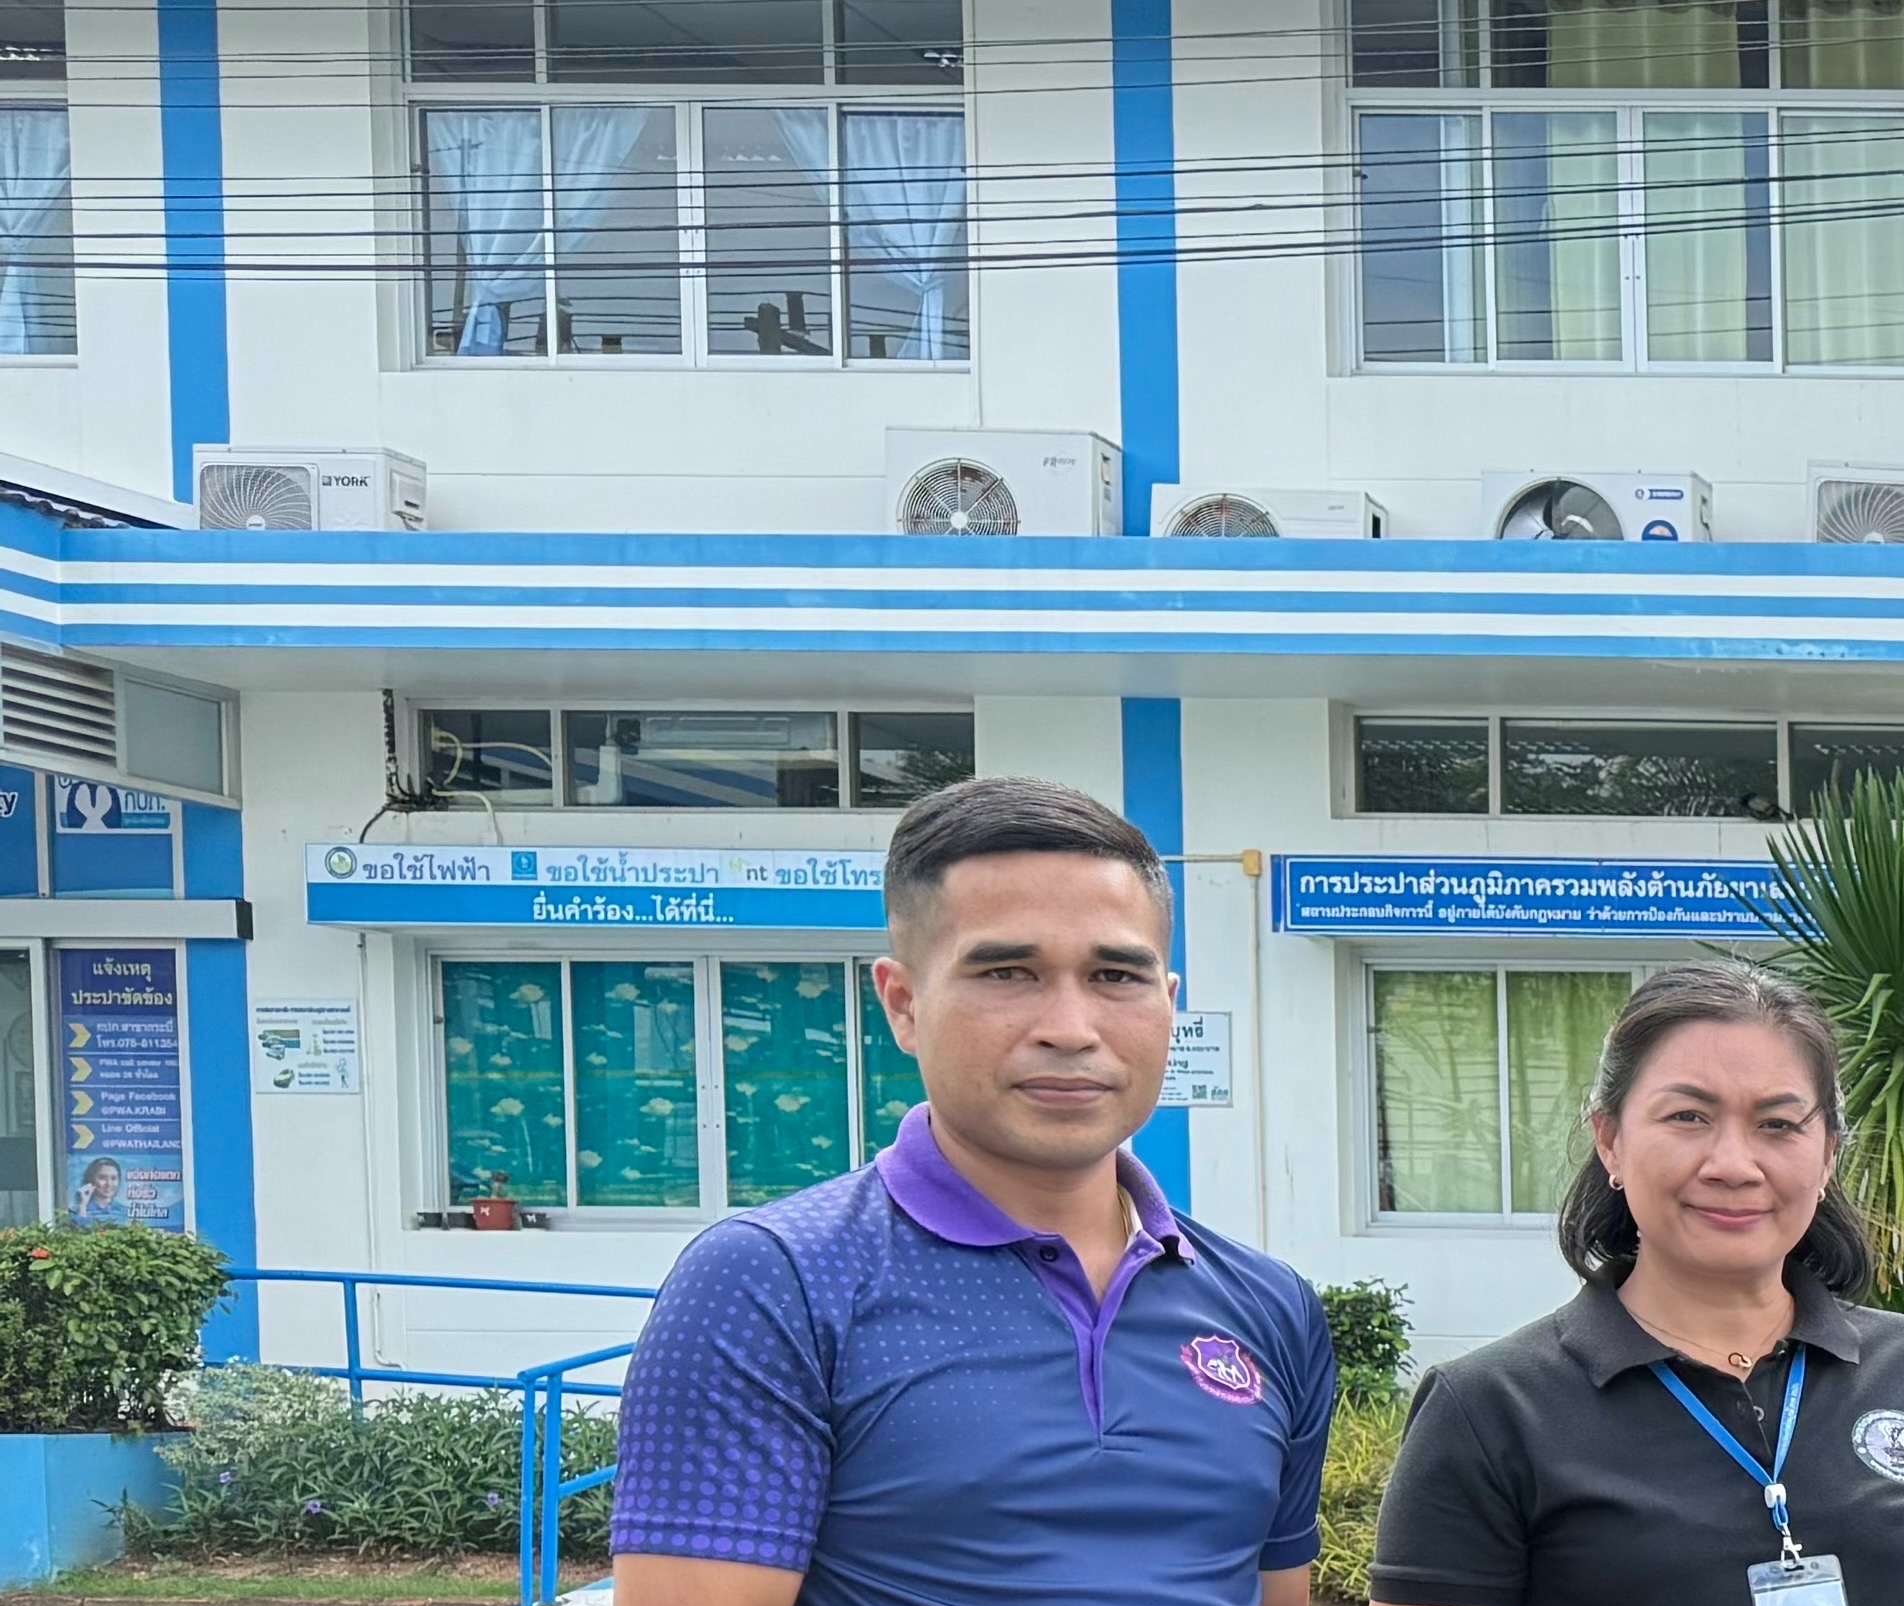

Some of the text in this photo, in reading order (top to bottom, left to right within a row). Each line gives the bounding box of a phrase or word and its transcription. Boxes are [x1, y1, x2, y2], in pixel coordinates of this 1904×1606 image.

[333, 475, 371, 487] YORK
[362, 852, 491, 881] ขอใช้ไฟฟ้า
[546, 851, 719, 884] ขอใช้น้ำประปา
[746, 865, 768, 882] nt
[92, 957, 152, 982] แจ้งเหตุ
[71, 986, 173, 1006] ประปาขัดข้อง
[128, 1091, 177, 1102] Facebook
[102, 1123, 123, 1134] Line
